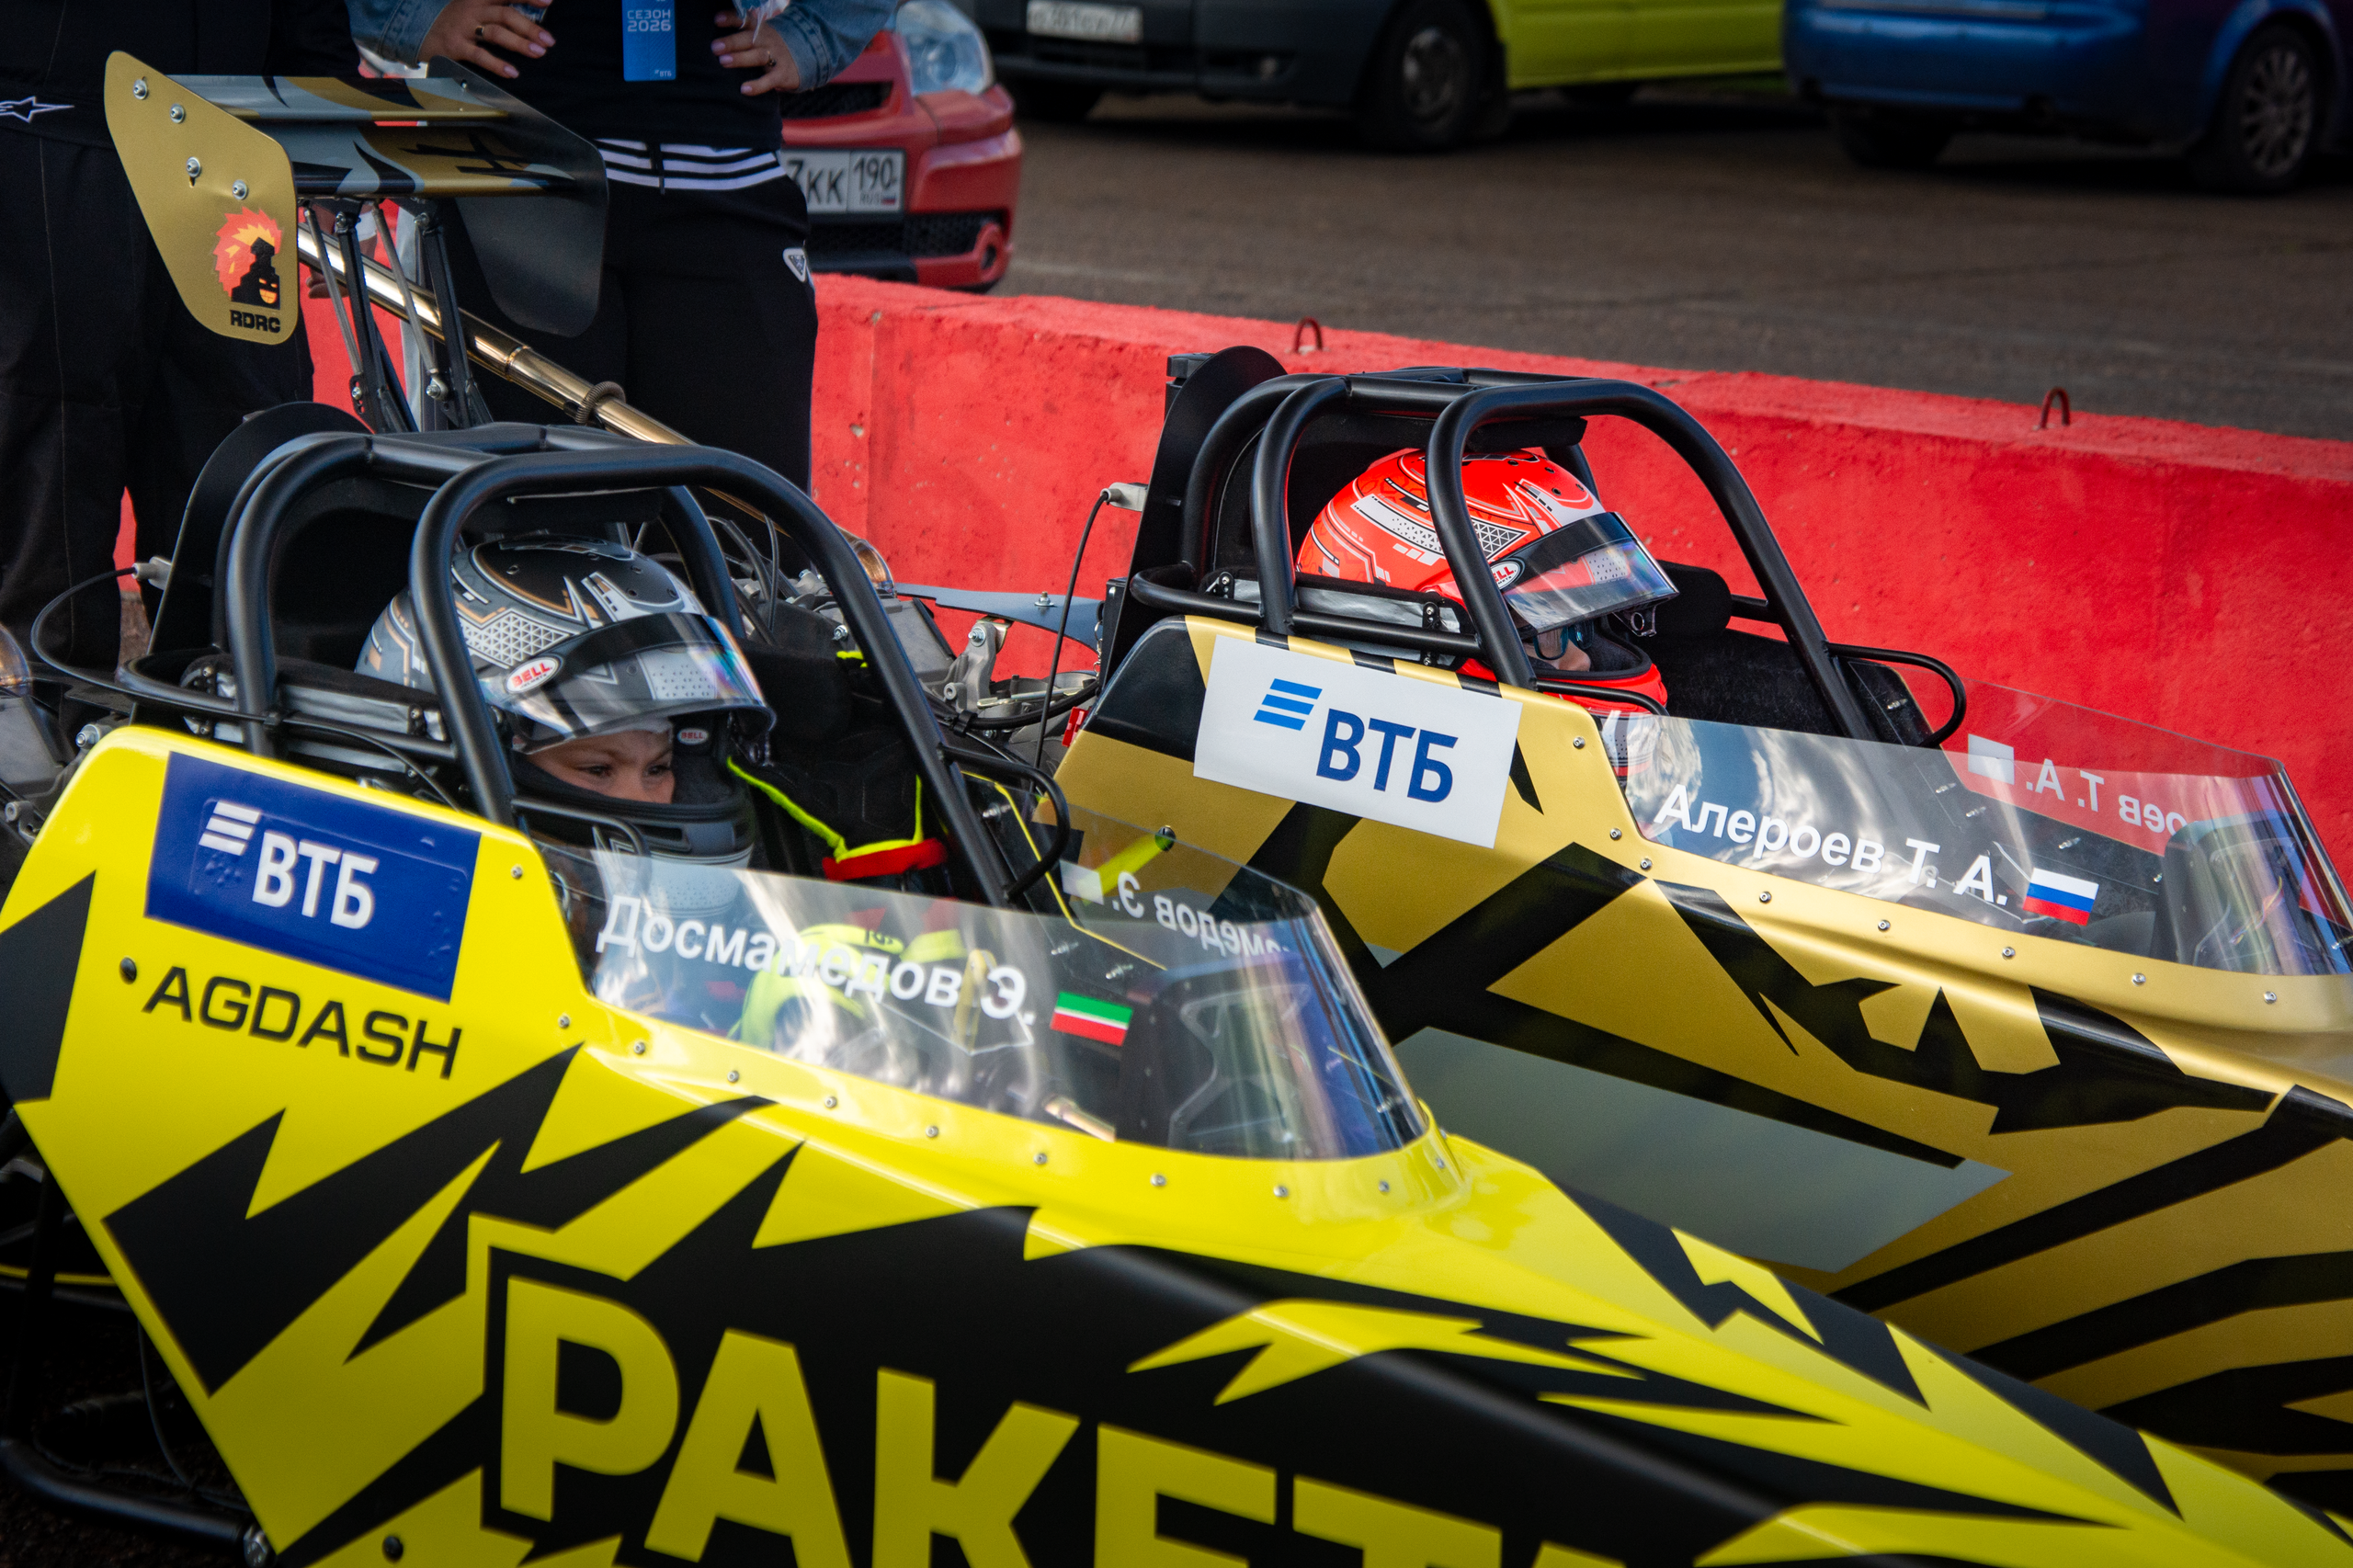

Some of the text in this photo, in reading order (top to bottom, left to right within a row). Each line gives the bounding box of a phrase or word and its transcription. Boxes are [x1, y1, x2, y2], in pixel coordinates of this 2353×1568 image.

[627, 9, 671, 19] СЕЗОН
[627, 19, 672, 32] 2026
[787, 154, 893, 204] 7КК 190
[230, 309, 280, 334] RDRC
[511, 662, 551, 688] BELL
[1315, 708, 1459, 803] ВТБ
[252, 830, 380, 930] ВТБ
[1654, 783, 2007, 905] Алероев Т. А.
[596, 894, 1035, 1026] Досмамедов Э.
[141, 965, 462, 1081] AGDASH
[499, 1275, 1627, 1568] РАКЕТ
